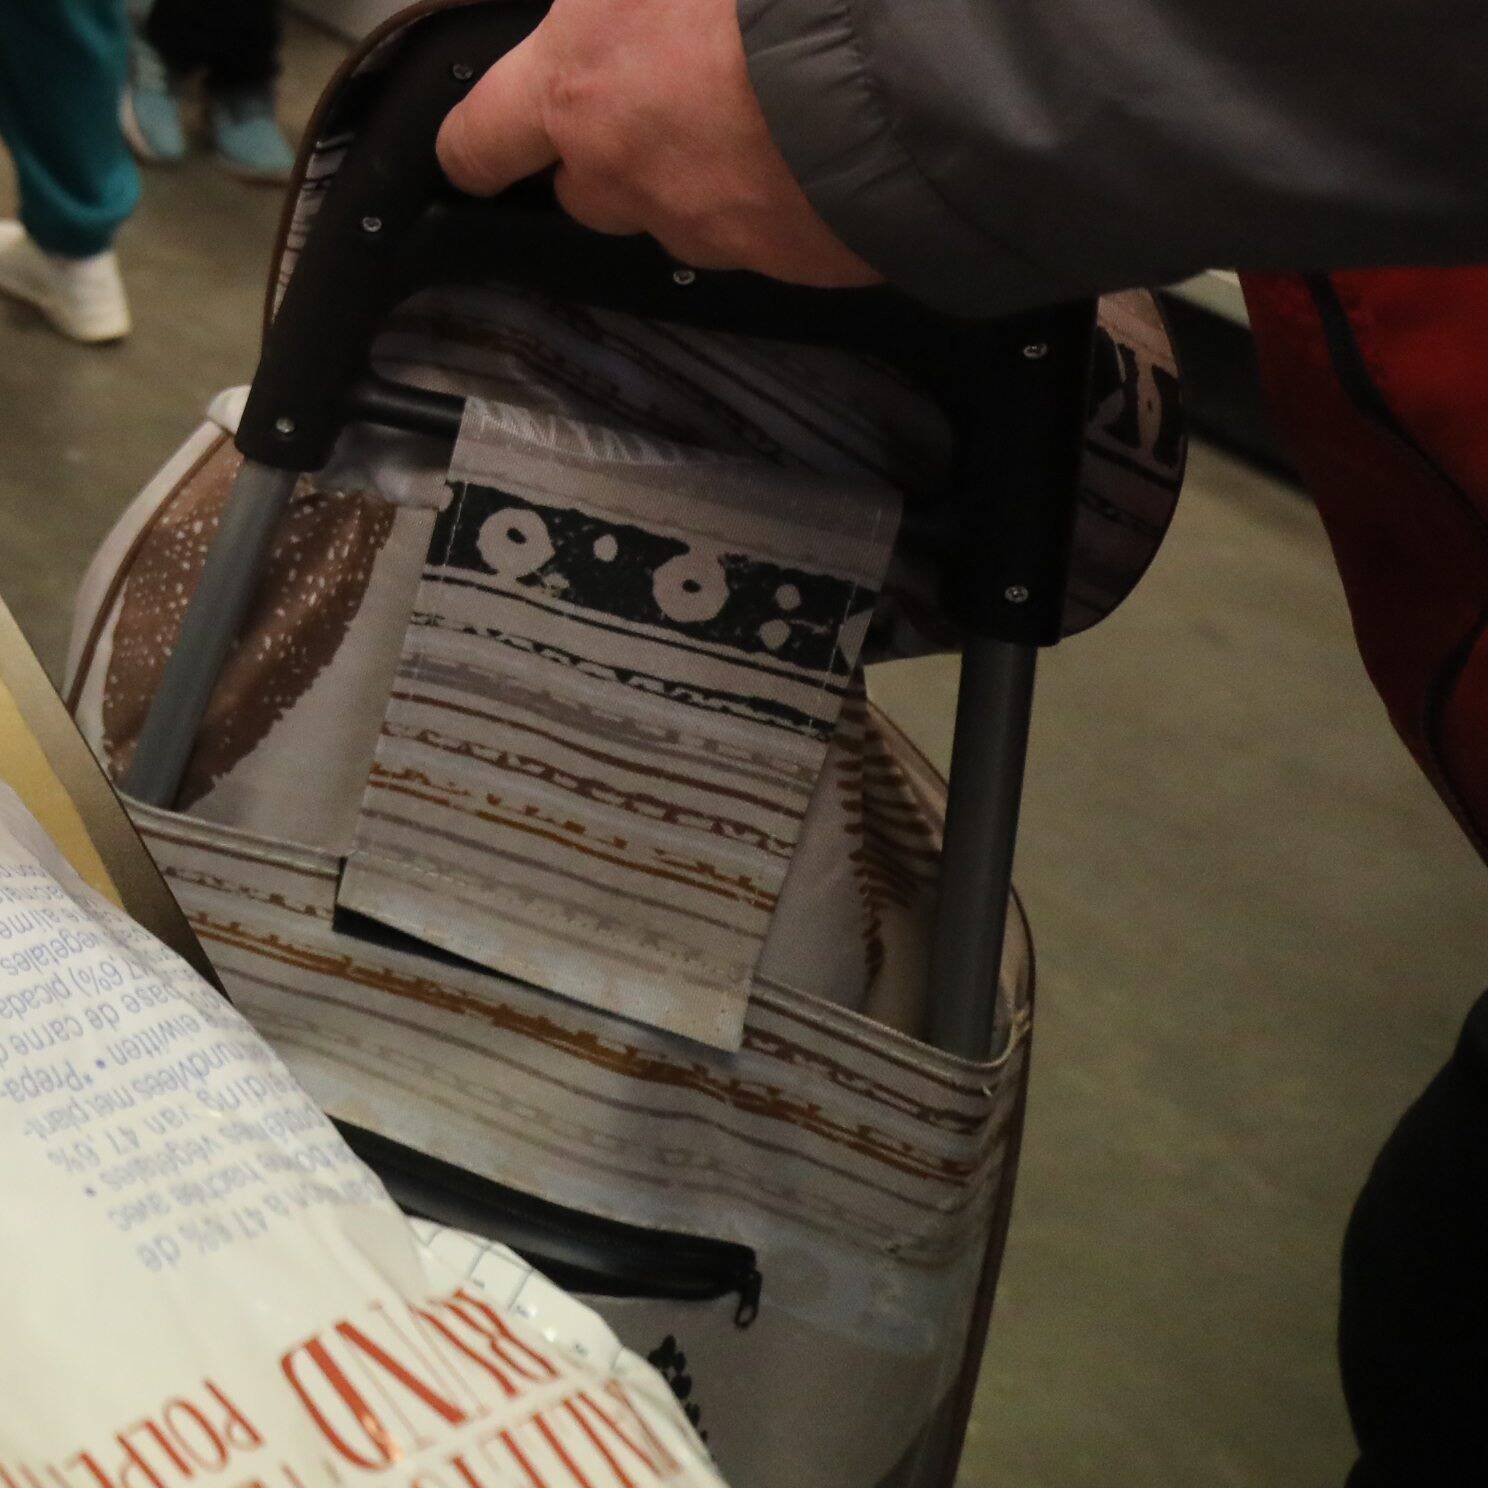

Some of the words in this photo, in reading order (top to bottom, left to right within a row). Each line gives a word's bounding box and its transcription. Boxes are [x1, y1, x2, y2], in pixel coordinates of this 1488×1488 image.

[7, 1009, 86, 1060] carne
[83, 998, 122, 1036] de
[279, 1286, 558, 1471] RUND
